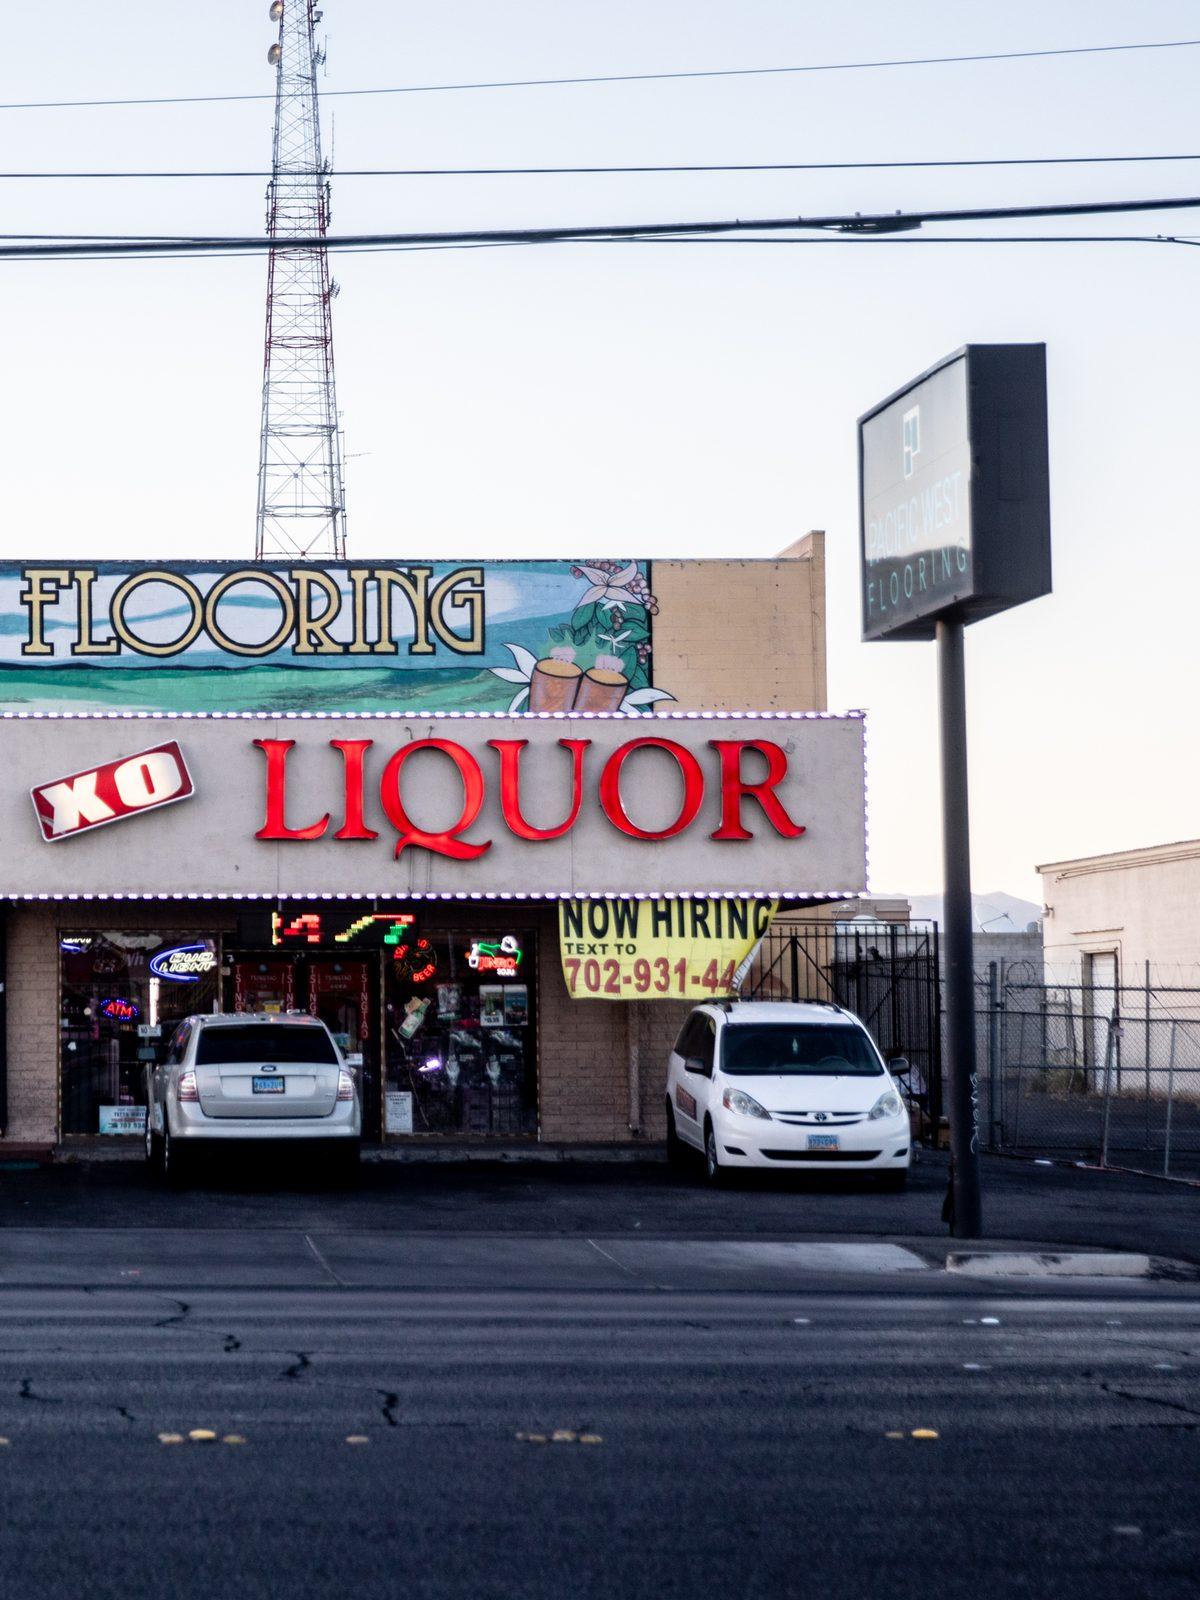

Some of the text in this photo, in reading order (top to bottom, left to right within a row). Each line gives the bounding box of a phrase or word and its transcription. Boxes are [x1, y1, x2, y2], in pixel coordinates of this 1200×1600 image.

[867, 537, 968, 616] FLOORING
[20, 566, 485, 658] FLOORING
[40, 752, 184, 836] XO
[252, 737, 806, 860] LIQUOR
[562, 897, 640, 939] NOW
[169, 951, 214, 963] BUD
[478, 956, 516, 971] JINRO
[564, 942, 637, 955] TEXT TO
[158, 960, 218, 973] LIGHT
[412, 962, 437, 983] BEER
[105, 1001, 133, 1017] ATM
[360, 963, 369, 1039] TSINGTAO
